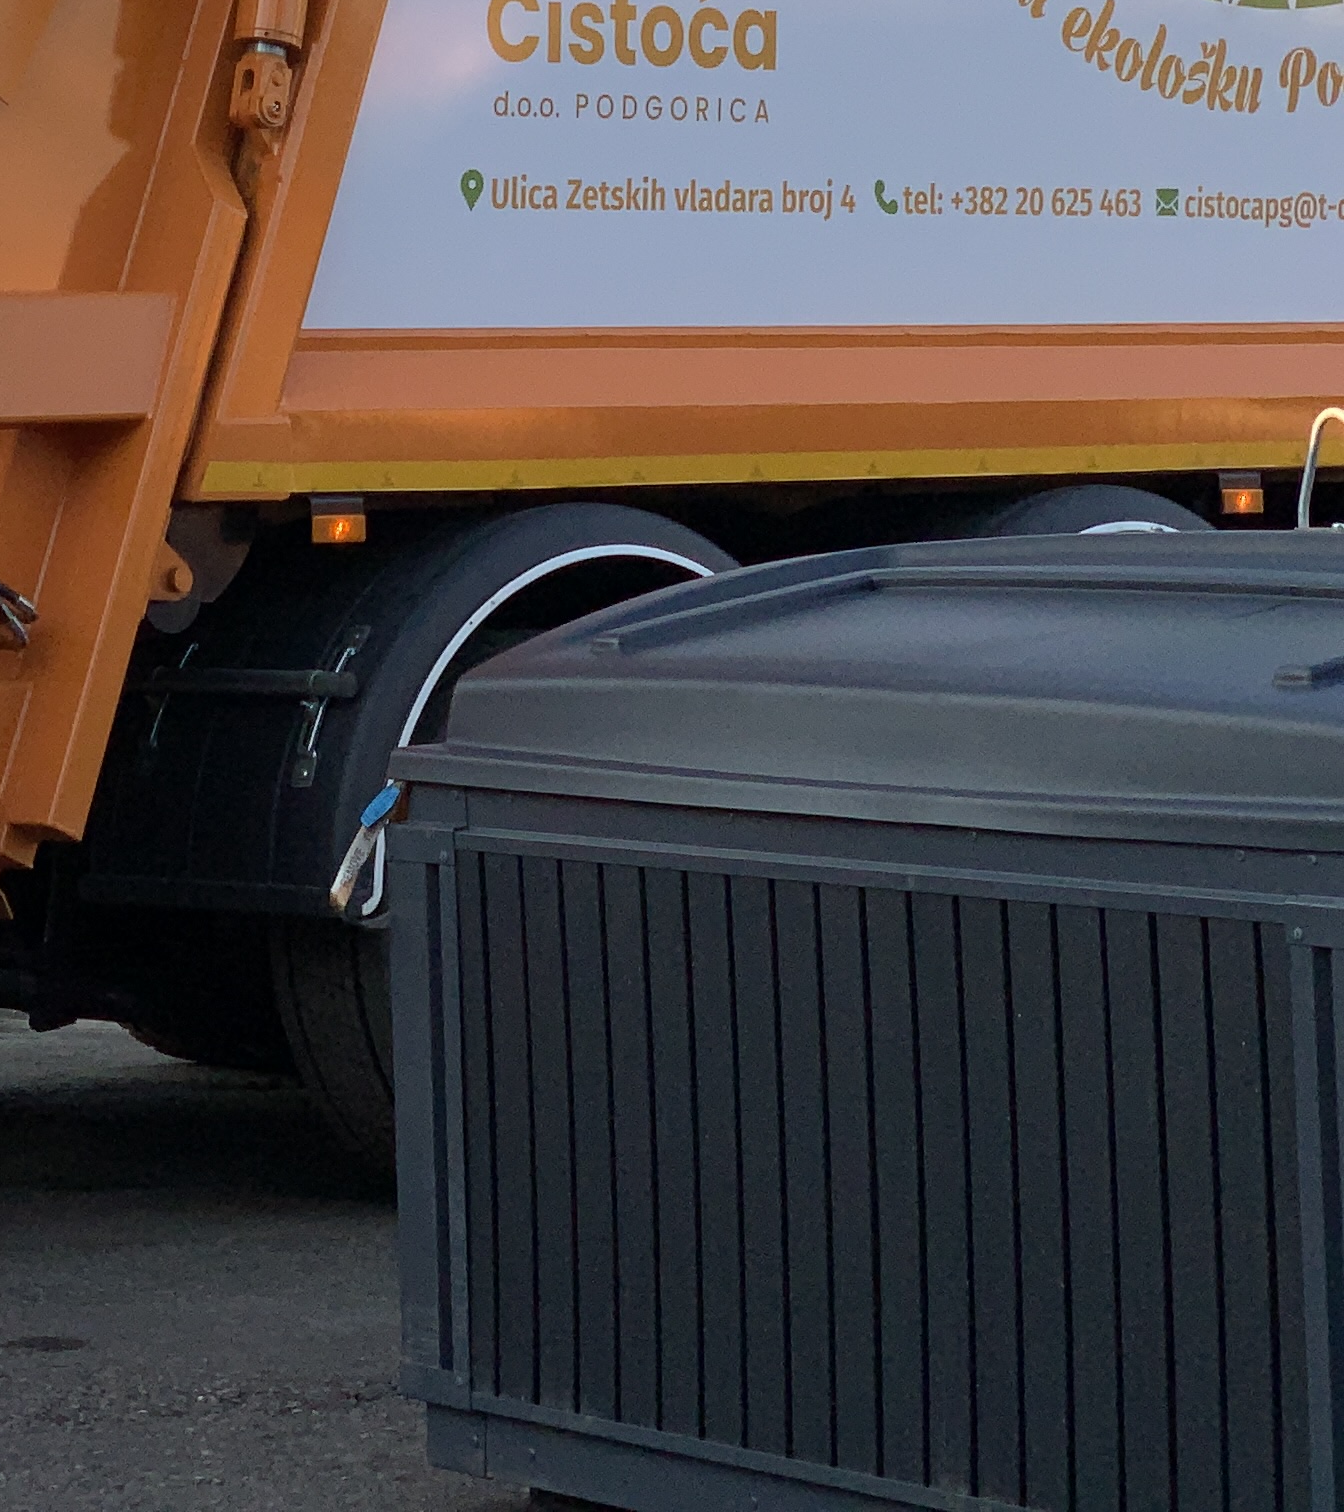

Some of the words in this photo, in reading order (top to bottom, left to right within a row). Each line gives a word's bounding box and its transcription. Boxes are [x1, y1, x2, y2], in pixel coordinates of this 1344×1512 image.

[493, 90, 561, 118] d.o.o.
[575, 93, 770, 124] PODGORICA
[490, 173, 558, 211] Ulica
[565, 175, 665, 213] Zetskih
[673, 178, 774, 214] vladara
[781, 177, 834, 222] broj
[839, 183, 857, 214] 4
[902, 182, 944, 215] tel:
[950, 185, 1009, 216] +382
[1014, 186, 1045, 217] 20
[1051, 186, 1093, 217] 625
[1099, 188, 1142, 218] 463
